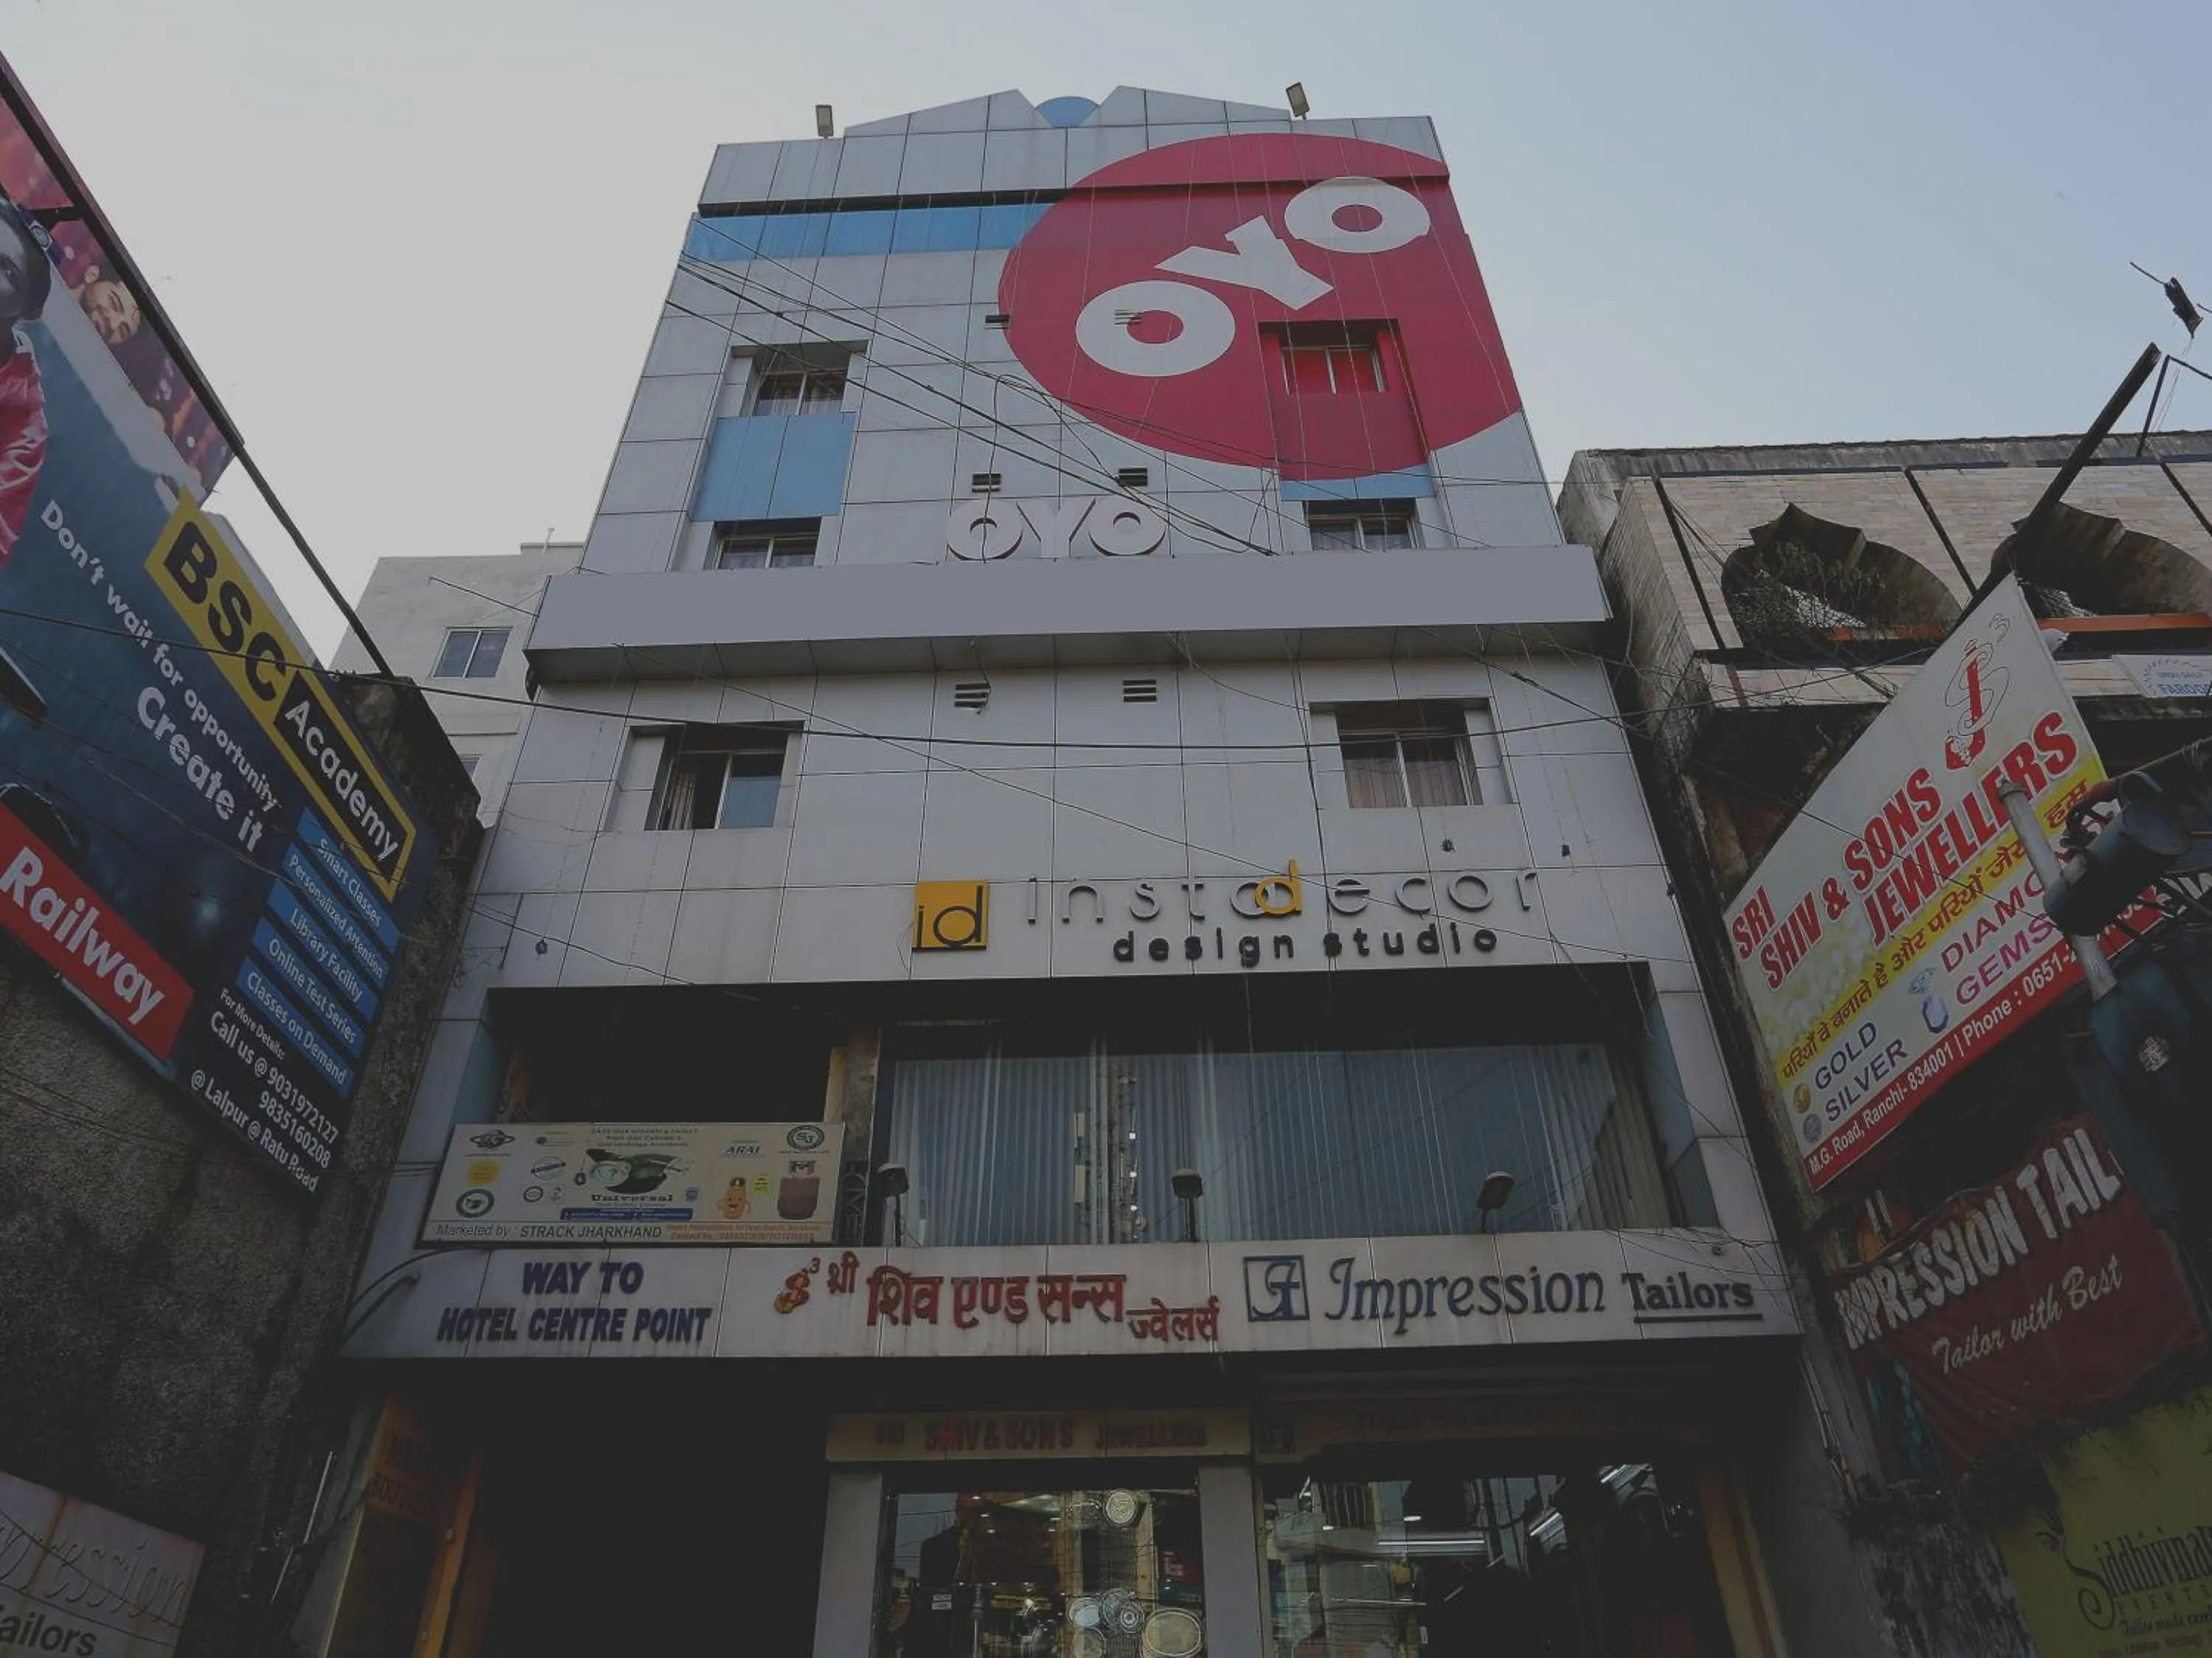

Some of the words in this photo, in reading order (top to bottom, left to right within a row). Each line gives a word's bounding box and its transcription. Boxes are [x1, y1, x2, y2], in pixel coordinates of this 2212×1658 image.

[1076, 177, 1431, 378] OYO
[946, 498, 1166, 561] OYO
[41, 499, 105, 586] Don't
[107, 584, 153, 648] wait
[153, 644, 184, 686] for
[184, 689, 282, 812] opportunity
[164, 522, 285, 701] BSC
[136, 687, 235, 820] Create
[237, 810, 262, 851] it
[285, 700, 397, 861] Academy
[1863, 710, 2077, 948] JEWELLERS
[291, 854, 347, 930] Personalized
[344, 926, 383, 979] Attention
[319, 839, 349, 884] Smart
[349, 879, 382, 926] Classes
[1732, 885, 1776, 960] SRI
[1760, 891, 1823, 991] SHIV
[1822, 877, 1850, 922] &
[1844, 767, 1941, 892] SONS
[0, 845, 165, 1025] Railway
[290, 909, 328, 962] Library
[327, 957, 363, 1003] Facility
[1113, 926, 1293, 968] design
[1324, 921, 1497, 957] studio
[1956, 912, 2056, 1005] GEMS
[234, 1003, 255, 1032] More
[248, 972, 288, 1024] Classes
[288, 1020, 302, 1041] on
[304, 1032, 347, 1085] Demand
[269, 938, 305, 988] Online
[305, 979, 327, 1012] Test
[326, 1003, 356, 1044] Series
[211, 1010, 240, 1048] Call
[237, 1040, 254, 1064] us
[254, 1057, 268, 1078] @
[267, 1066, 339, 1144] 9031972127
[1809, 1147, 1833, 1173] M.G.
[1832, 1120, 1866, 1154] Road,
[1908, 1044, 1953, 1090] 834001
[1963, 999, 2012, 1047] Phone
[1815, 1022, 1877, 1089] GOLD
[1826, 1038, 1908, 1122] SILVER
[191, 1069, 206, 1091] @
[204, 1077, 250, 1128] Lalpur
[248, 1120, 261, 1140] @
[260, 1128, 289, 1165] Ratu
[287, 1154, 319, 1193] Road
[260, 1090, 331, 1169] 9835160208
[436, 1224, 493, 1237] Marketed
[495, 1225, 509, 1239] by
[520, 1225, 575, 1238] STRACK
[578, 1225, 662, 1239] JHARKHAND
[522, 1262, 593, 1294] WAY
[599, 1262, 644, 1294] TO
[437, 1308, 518, 1342] HOTEL
[528, 1308, 625, 1342] CENTRE
[633, 1308, 711, 1342] POINT
[866, 1265, 944, 1326] शिव
[1037, 1274, 1126, 1323] सन्स
[1325, 1256, 1604, 1333] Impression
[1621, 1270, 1755, 1311] Tailors
[1932, 1325, 2004, 1374] Tailor
[2011, 1283, 2062, 1342] with
[2062, 1253, 2124, 1311] Best
[0, 1604, 97, 1657] ailors
